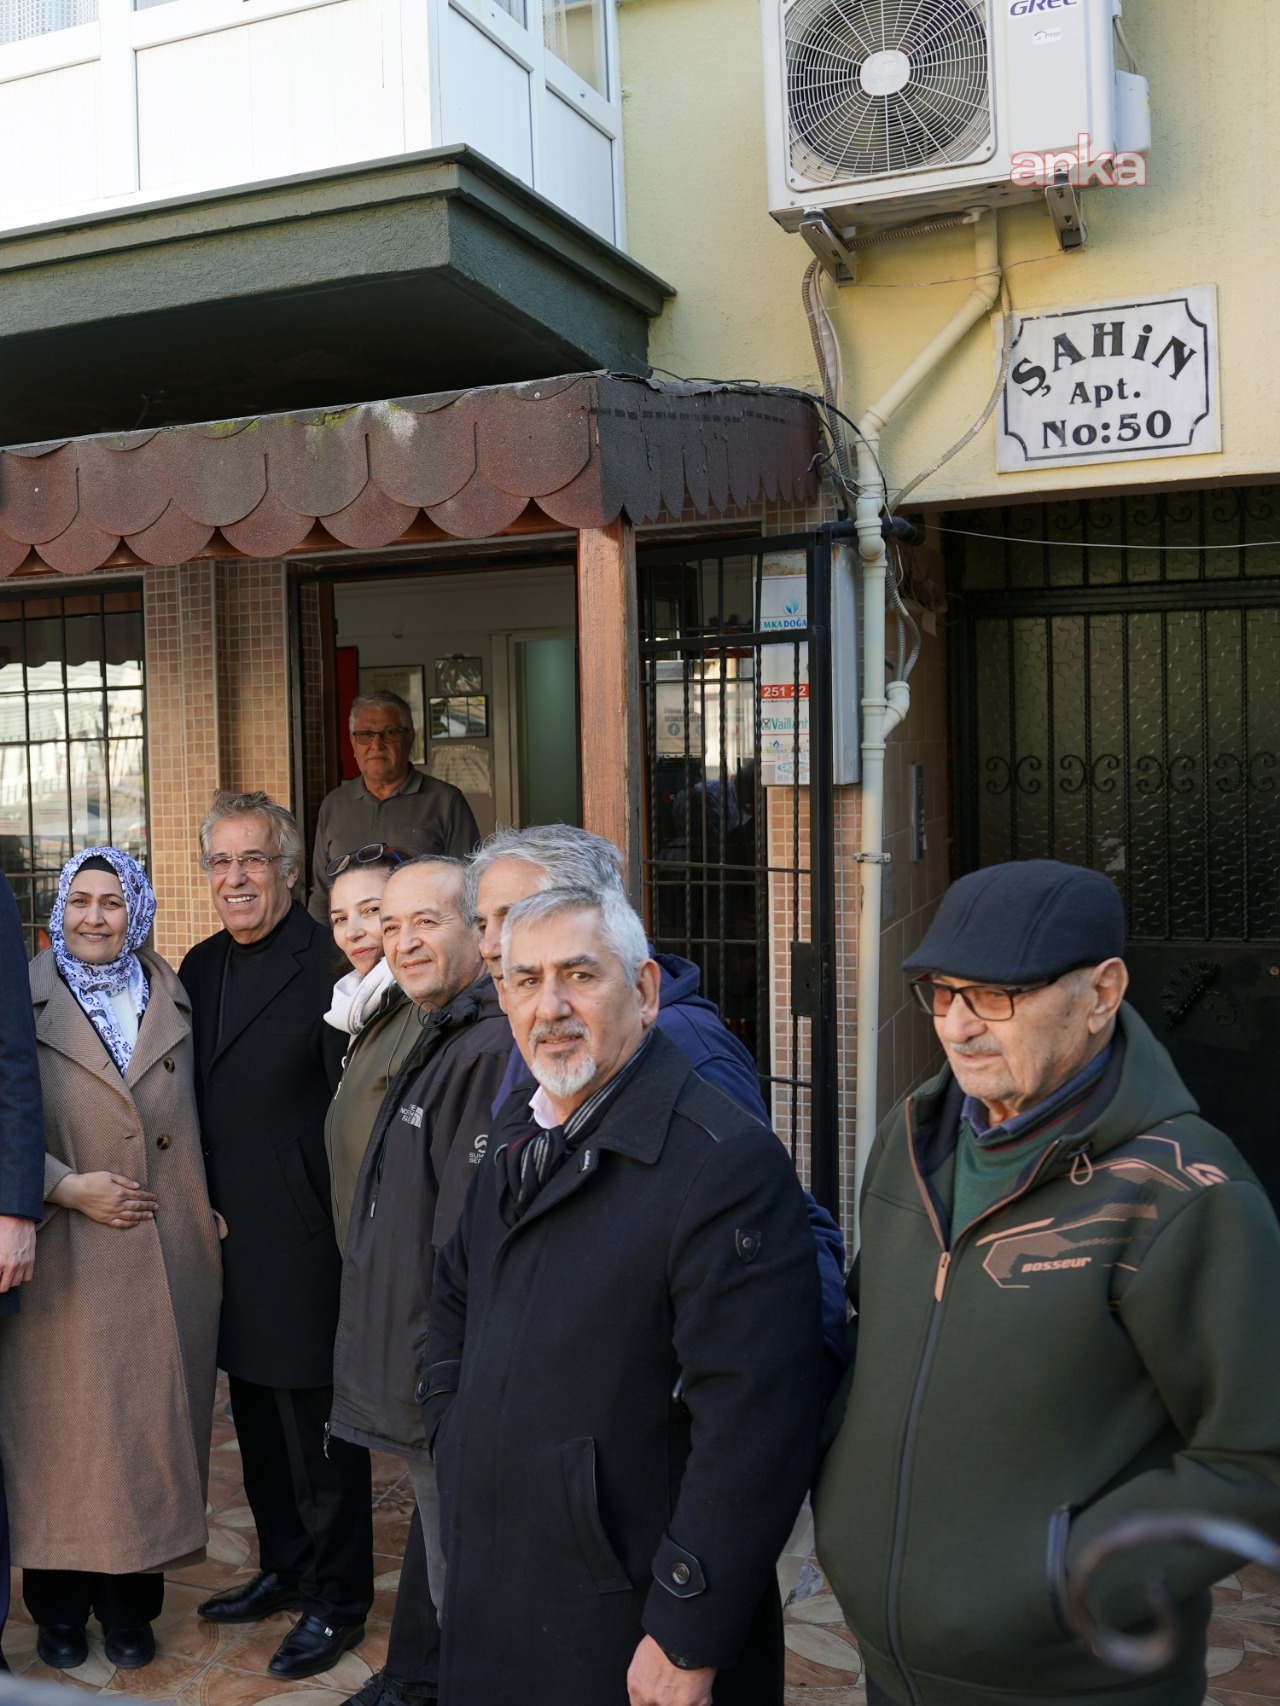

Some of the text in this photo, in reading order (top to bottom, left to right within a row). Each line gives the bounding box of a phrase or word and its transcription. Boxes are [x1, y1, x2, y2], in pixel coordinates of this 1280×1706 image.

[1069, 377, 1141, 409] Apt.
[1042, 410, 1172, 449] No:50
[783, 618, 807, 628] DOĞA
[763, 686, 786, 698] 251
[771, 716, 809, 731] Vaillnt
